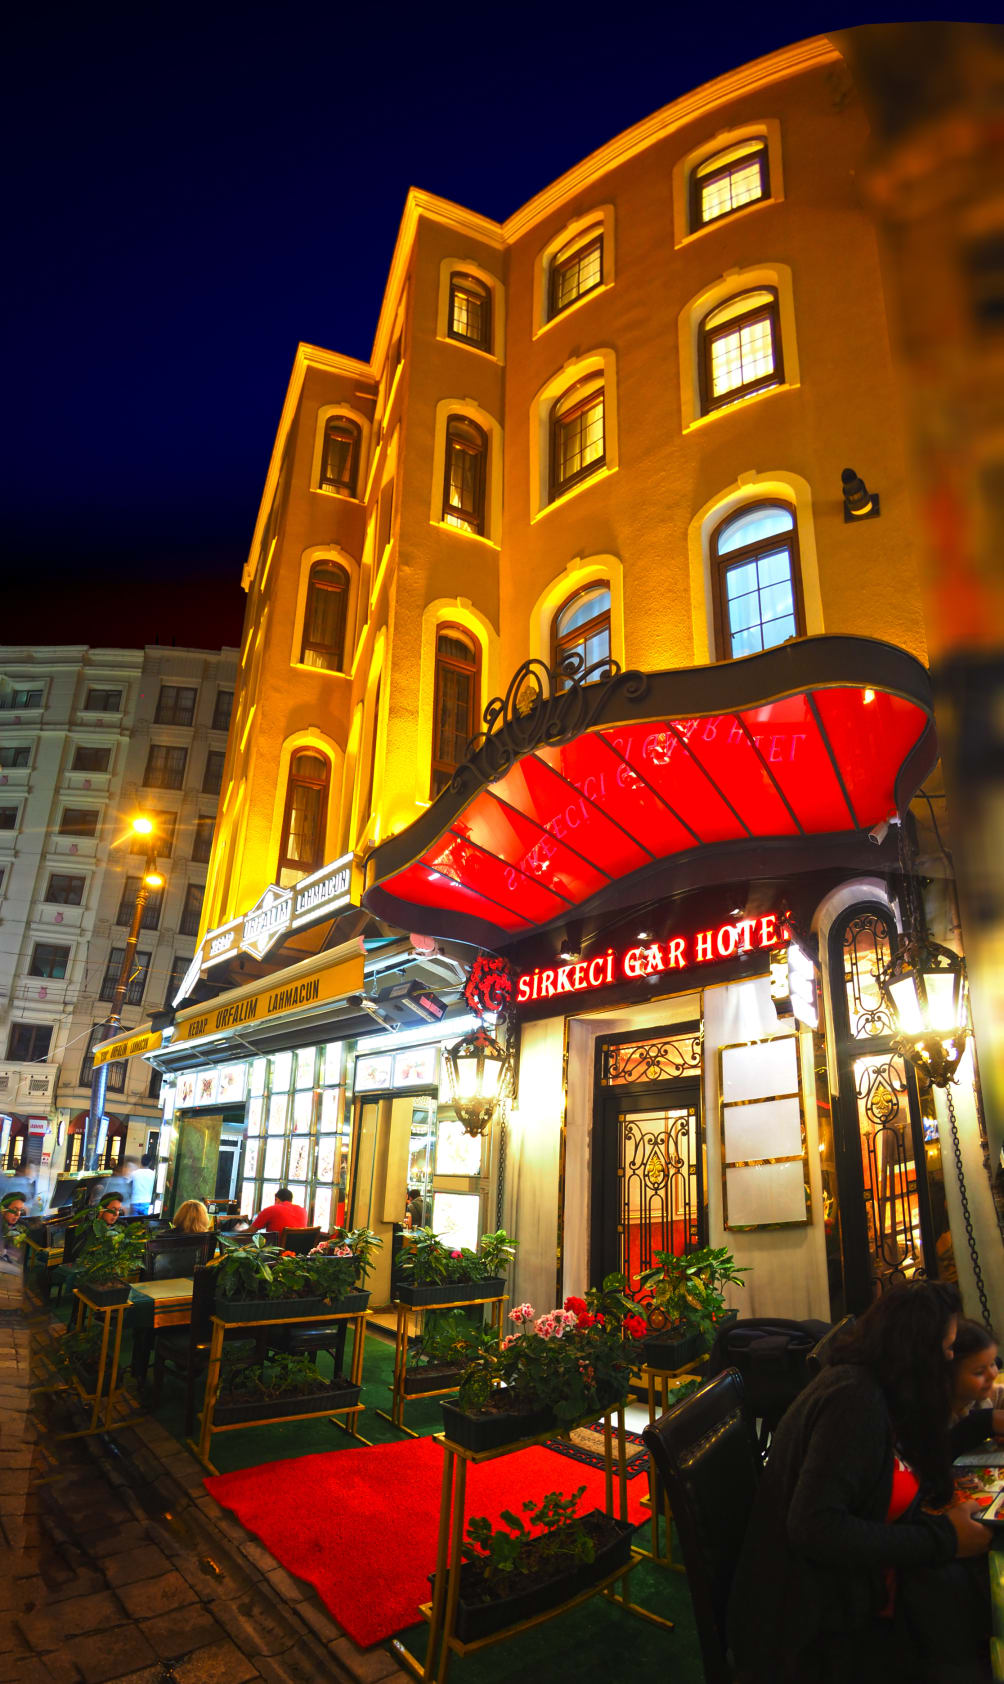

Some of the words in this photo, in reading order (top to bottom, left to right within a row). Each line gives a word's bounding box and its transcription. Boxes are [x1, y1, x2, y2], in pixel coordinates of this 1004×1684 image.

[295, 869, 350, 915] LAHMACUN
[517, 949, 614, 1003] SİRKECİ
[623, 938, 687, 977] GAR
[187, 1017, 209, 1037] KEBAP
[215, 997, 258, 1029] URFALIM
[267, 978, 320, 1013] LAHMACUN
